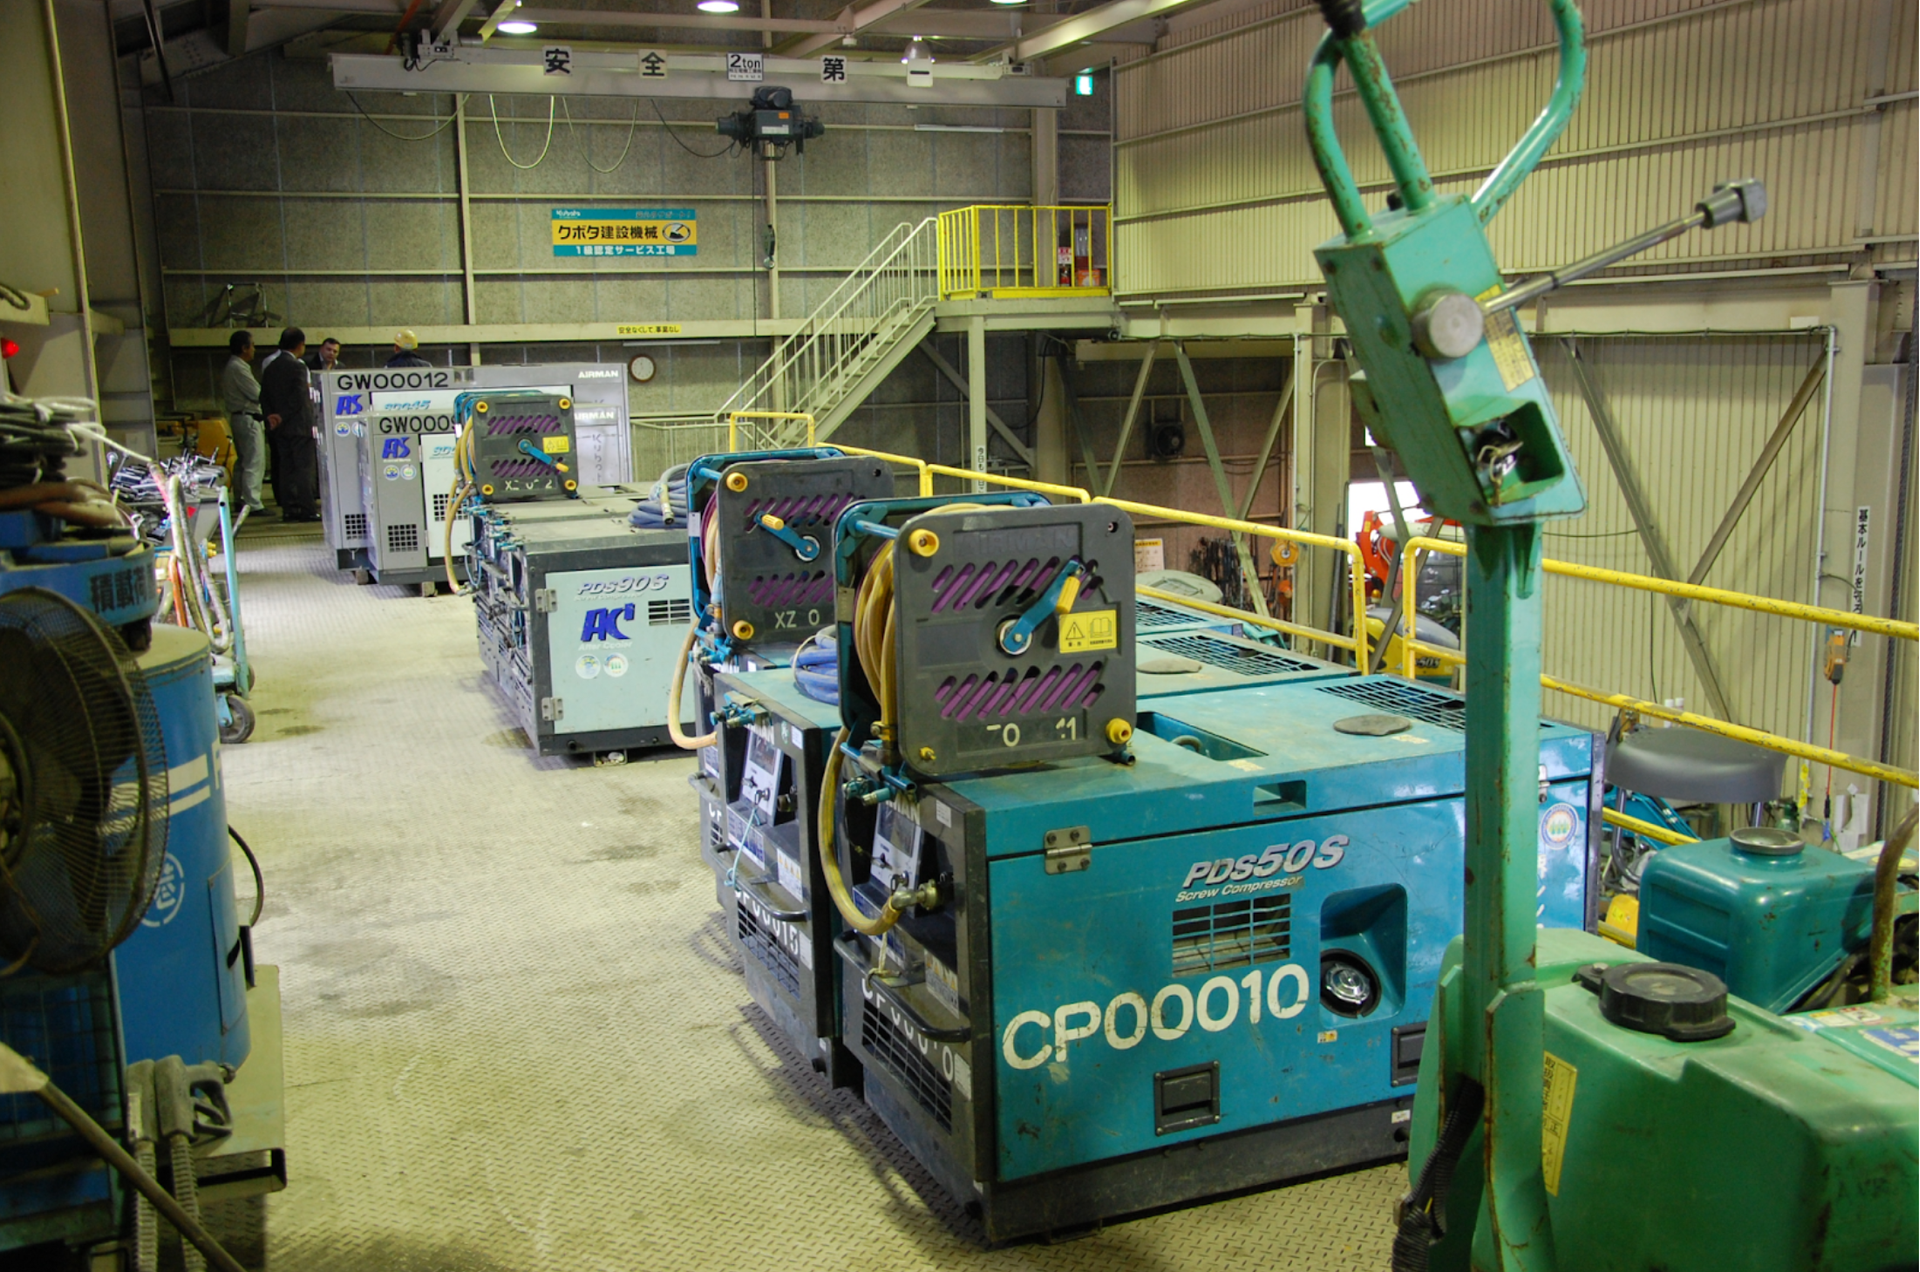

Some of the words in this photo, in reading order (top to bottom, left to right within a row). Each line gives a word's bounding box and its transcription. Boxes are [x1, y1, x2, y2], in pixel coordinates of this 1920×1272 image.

[545, 49, 570, 74] 安
[641, 52, 665, 77] 全
[822, 57, 845, 82] 第
[730, 54, 761, 69] 2ton
[558, 225, 658, 240] クボタ建設機械
[337, 371, 449, 391] GW00012
[578, 370, 619, 379] AIRMAN
[1182, 834, 1350, 888] PDS50S
[1175, 886, 1220, 903] Screw
[1221, 875, 1303, 894] Compressor
[1002, 963, 1310, 1070] CP00010
